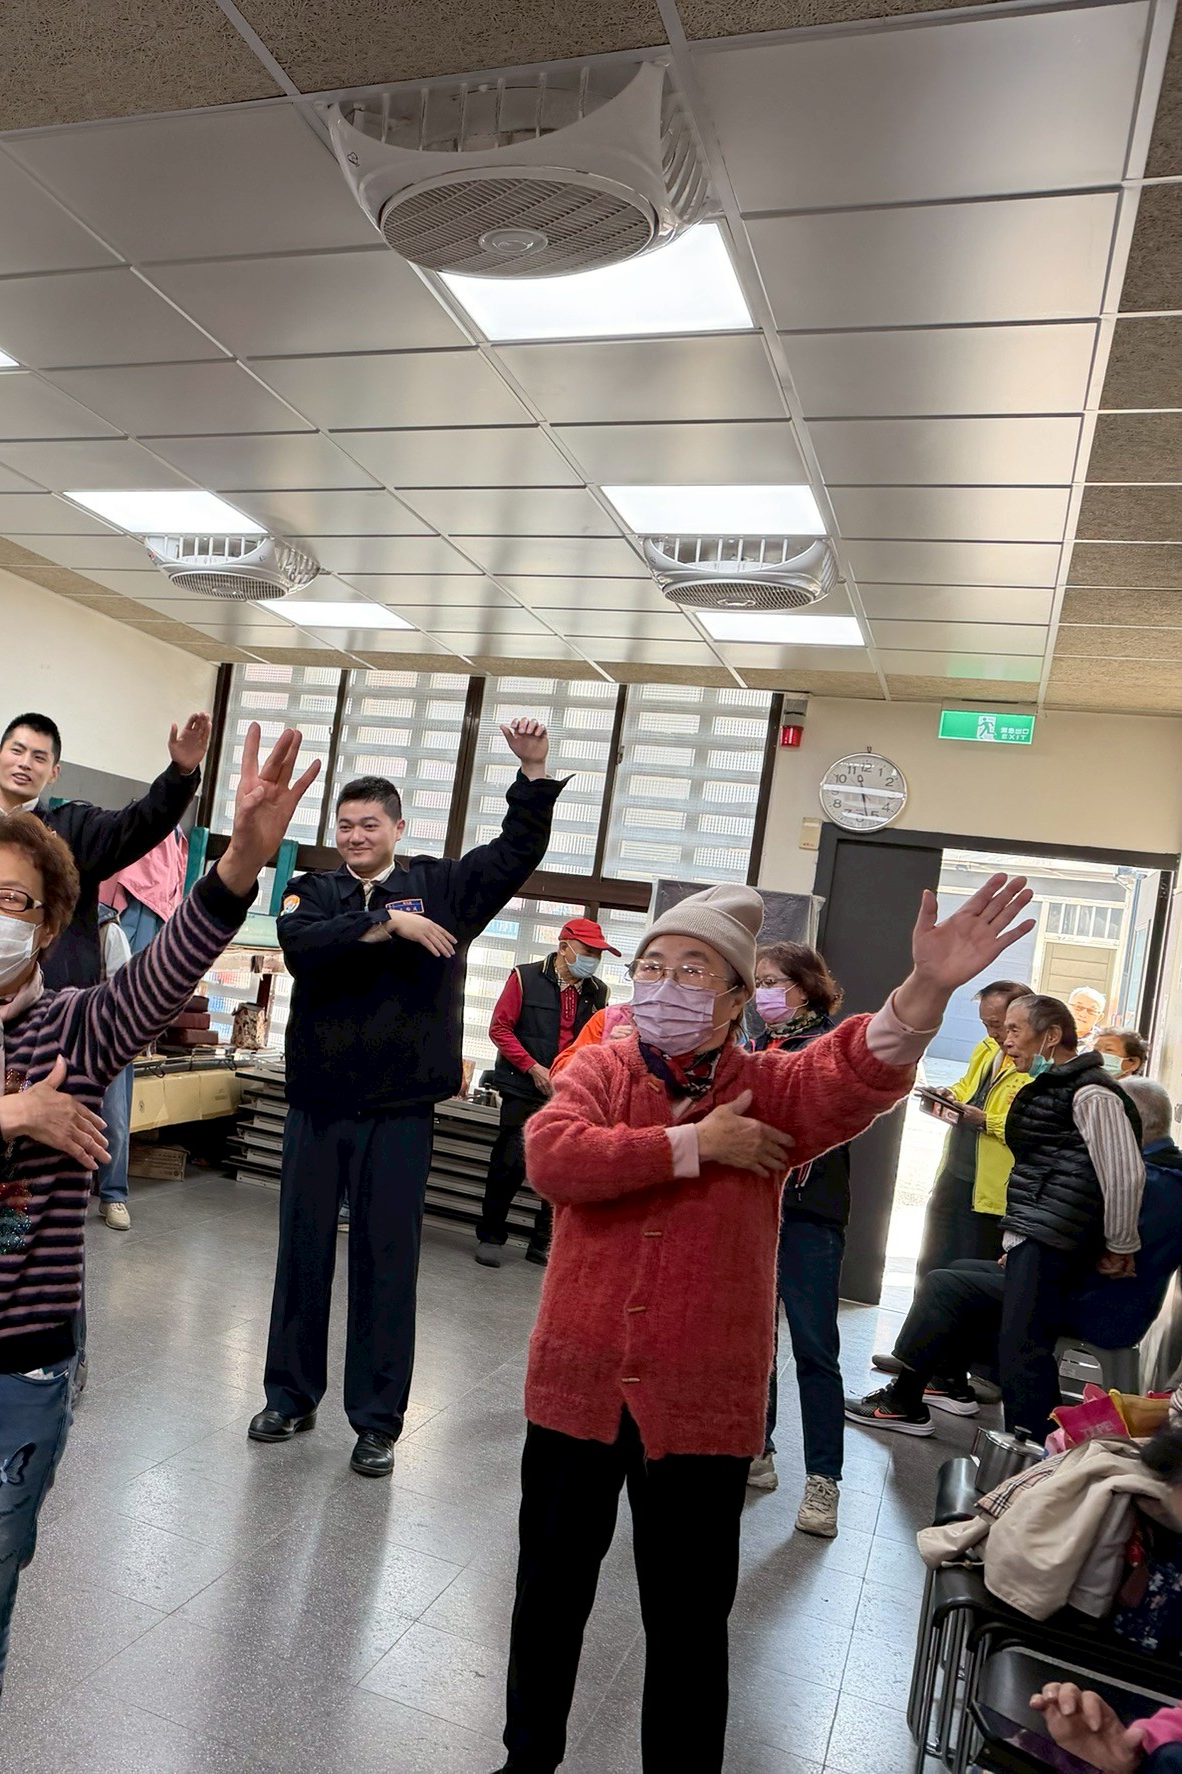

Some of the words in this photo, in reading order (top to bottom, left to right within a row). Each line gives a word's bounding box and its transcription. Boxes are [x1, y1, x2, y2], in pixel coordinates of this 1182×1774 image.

[1001, 733, 1027, 741] EXIT
[847, 765, 857, 775] 11
[861, 762, 872, 773] 12
[878, 767, 883, 777] 1
[833, 773, 847, 784] 10
[885, 777, 894, 787] 2
[833, 798, 842, 809] 8
[881, 802, 891, 813] 4
